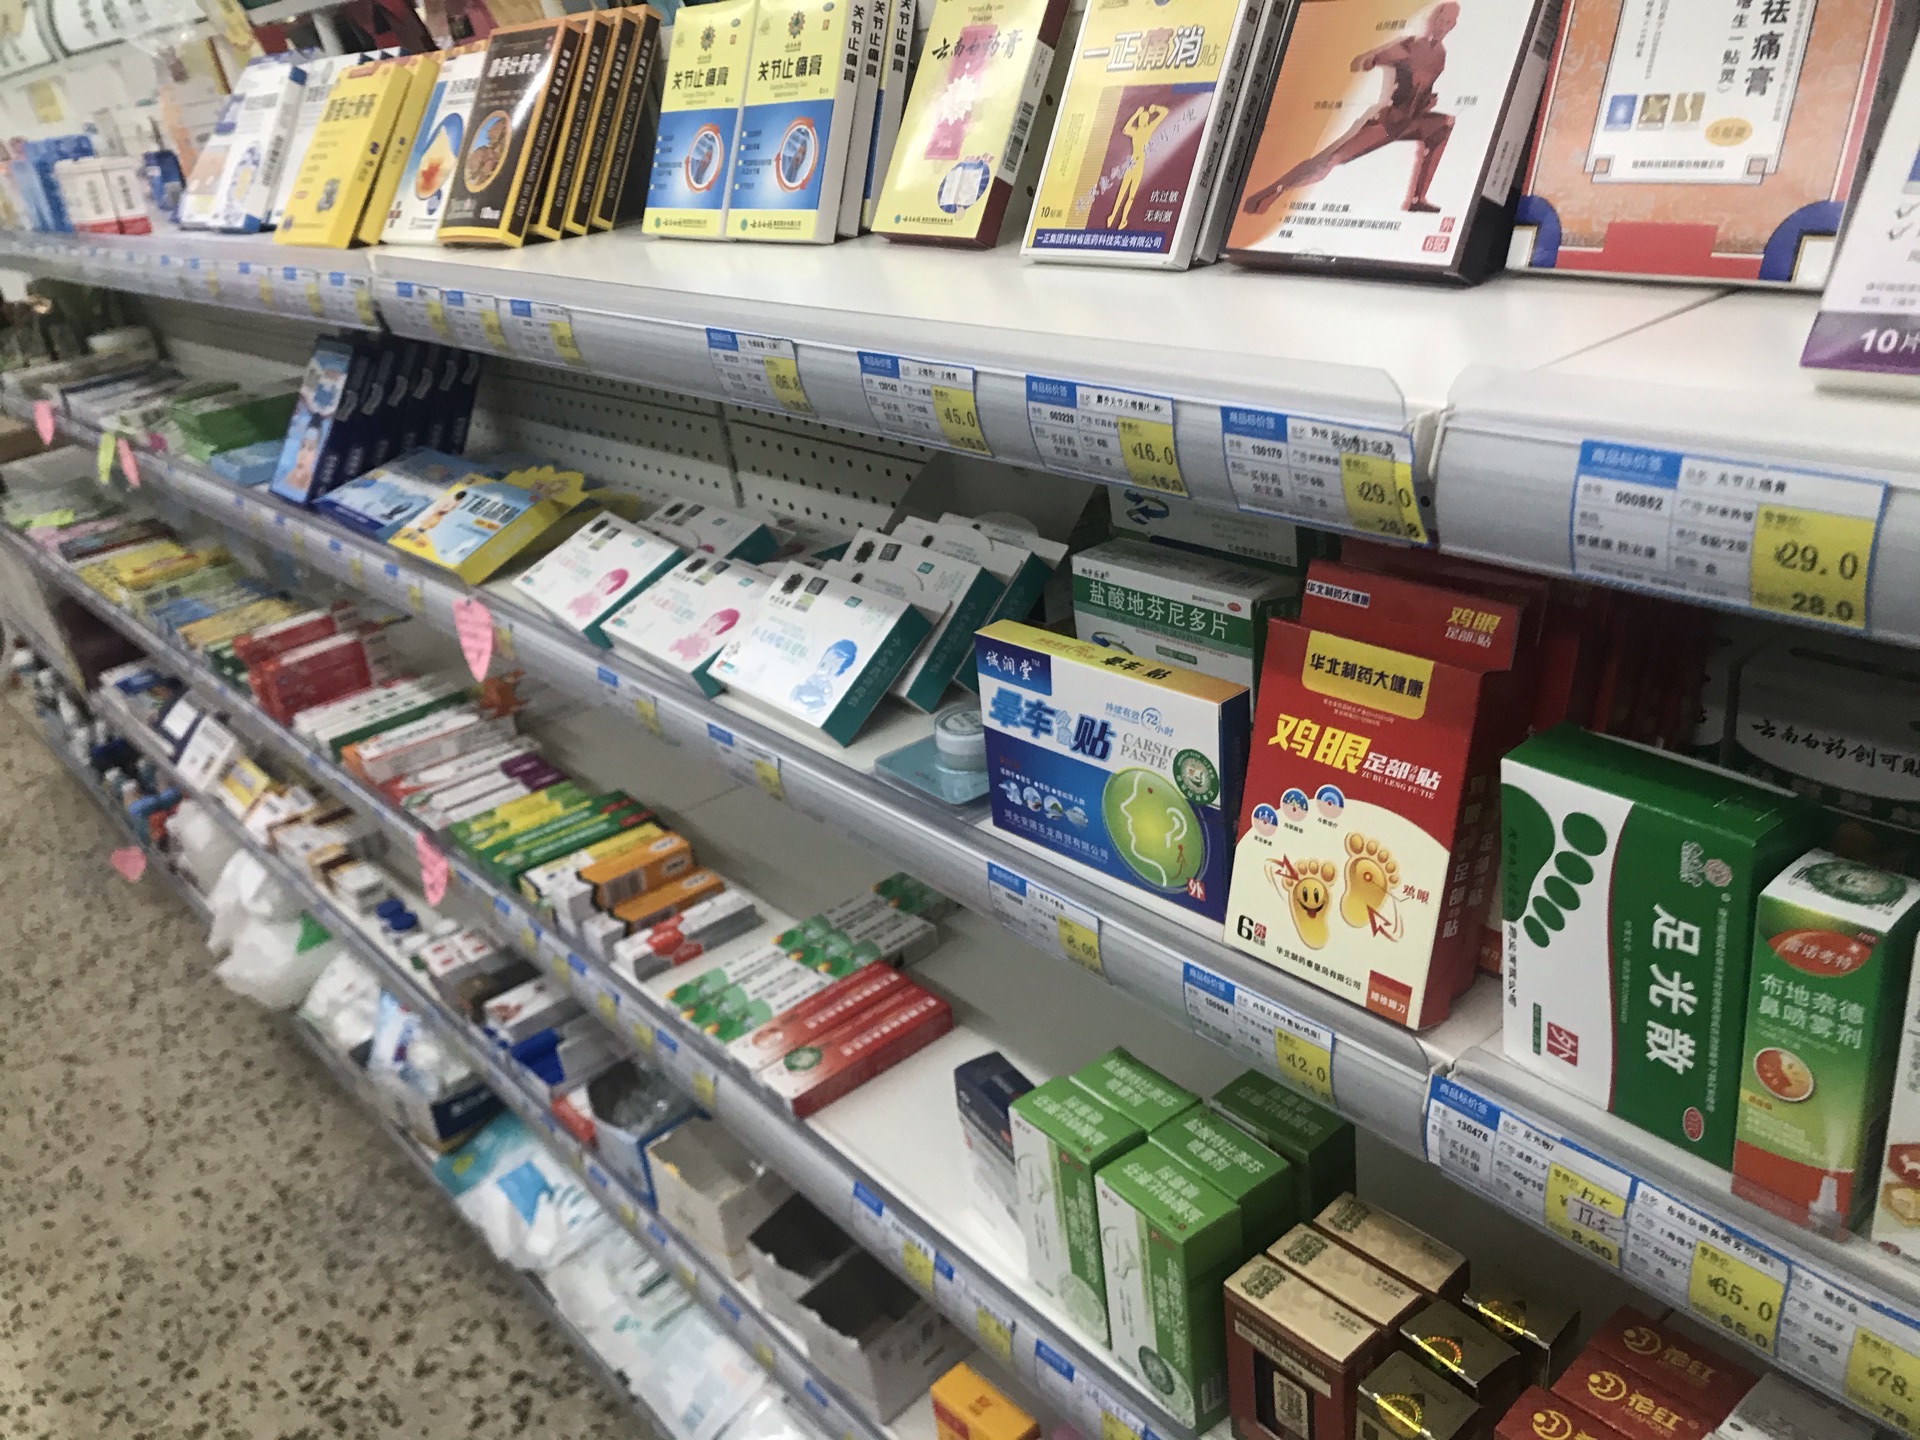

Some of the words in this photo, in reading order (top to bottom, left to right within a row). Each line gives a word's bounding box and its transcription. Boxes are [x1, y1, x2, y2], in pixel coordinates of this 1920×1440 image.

[931, 29, 1023, 60] 云南白药膏
[671, 66, 729, 91] 关节止痛膏
[757, 54, 823, 81] 关节止痛膏
[1149, 190, 1180, 203] 抗过敏
[1144, 209, 1173, 223] 无刺激
[1306, 580, 1370, 607] 华北制药大健康
[1089, 580, 1229, 640] 盐酸地芬尼多片
[1446, 606, 1502, 633] 鸡眼
[985, 650, 1032, 682] 诚润堂
[1309, 652, 1425, 700] 华北制药大健康
[1145, 711, 1159, 727] 72
[1119, 743, 1169, 771] PASTE
[1267, 712, 1373, 775] 鸡眼
[1384, 777, 1407, 792] LENG
[1402, 884, 1430, 904] 鸡眼
[1236, 914, 1253, 941] 6
[1645, 902, 1702, 1076] 足光散
[1760, 973, 1866, 1026] 布地奈德
[1758, 995, 1864, 1049] 鼻喷雾剂
[1439, 1082, 1489, 1117] 商品标价签
[1706, 1273, 1774, 1322] ¥65.0
